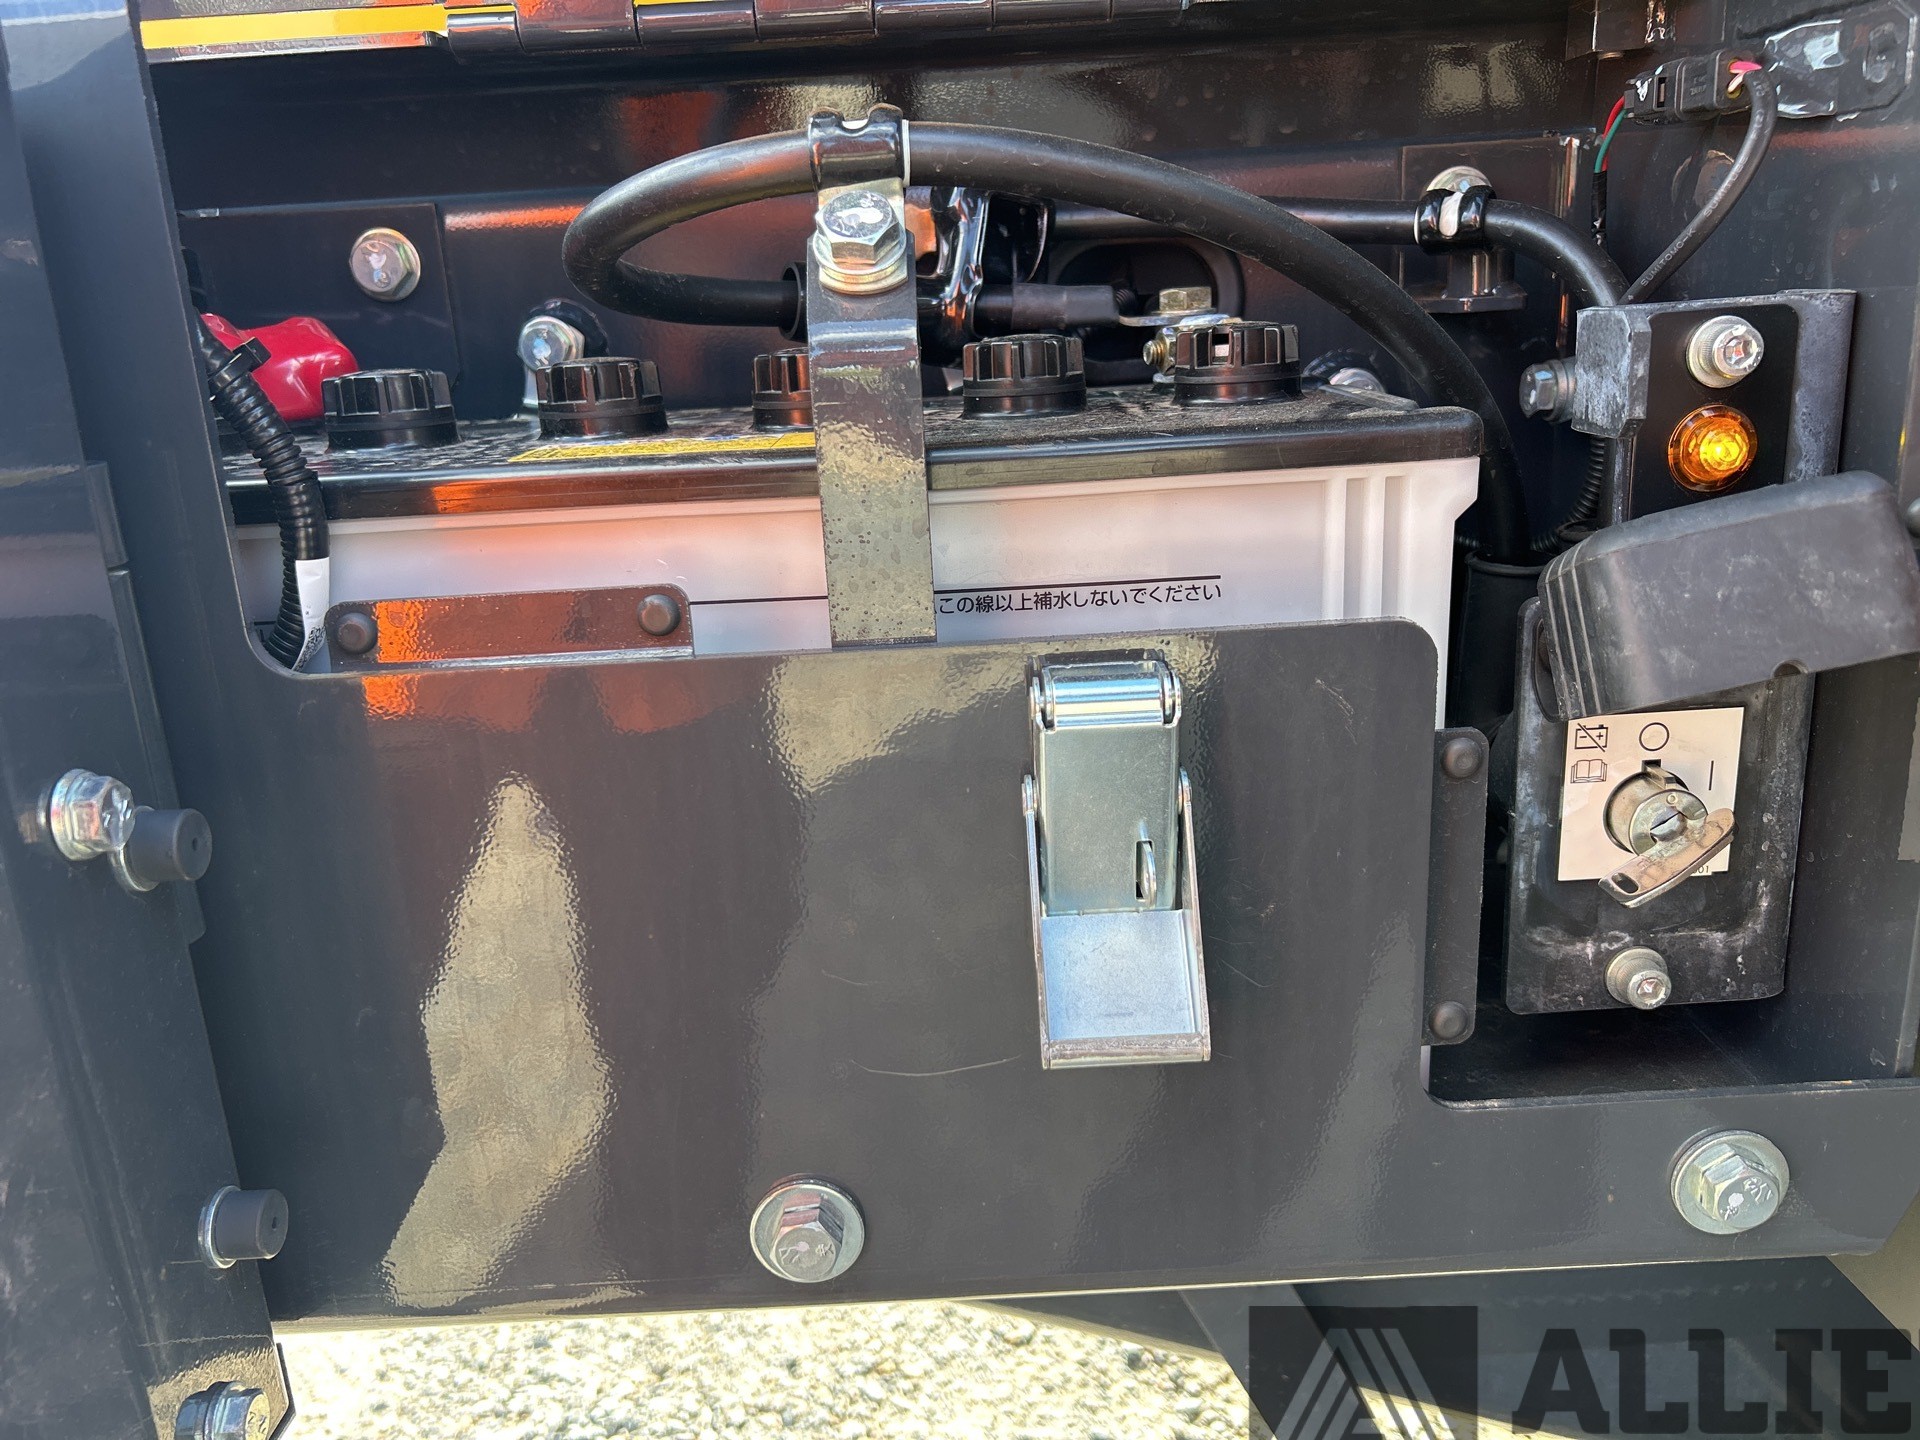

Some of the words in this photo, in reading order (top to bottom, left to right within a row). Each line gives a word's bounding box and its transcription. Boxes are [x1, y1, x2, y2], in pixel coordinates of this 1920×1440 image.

[1640, 228, 1697, 287] SUMITOMO-K
[939, 584, 1222, 614] この線以上補水しないでください
